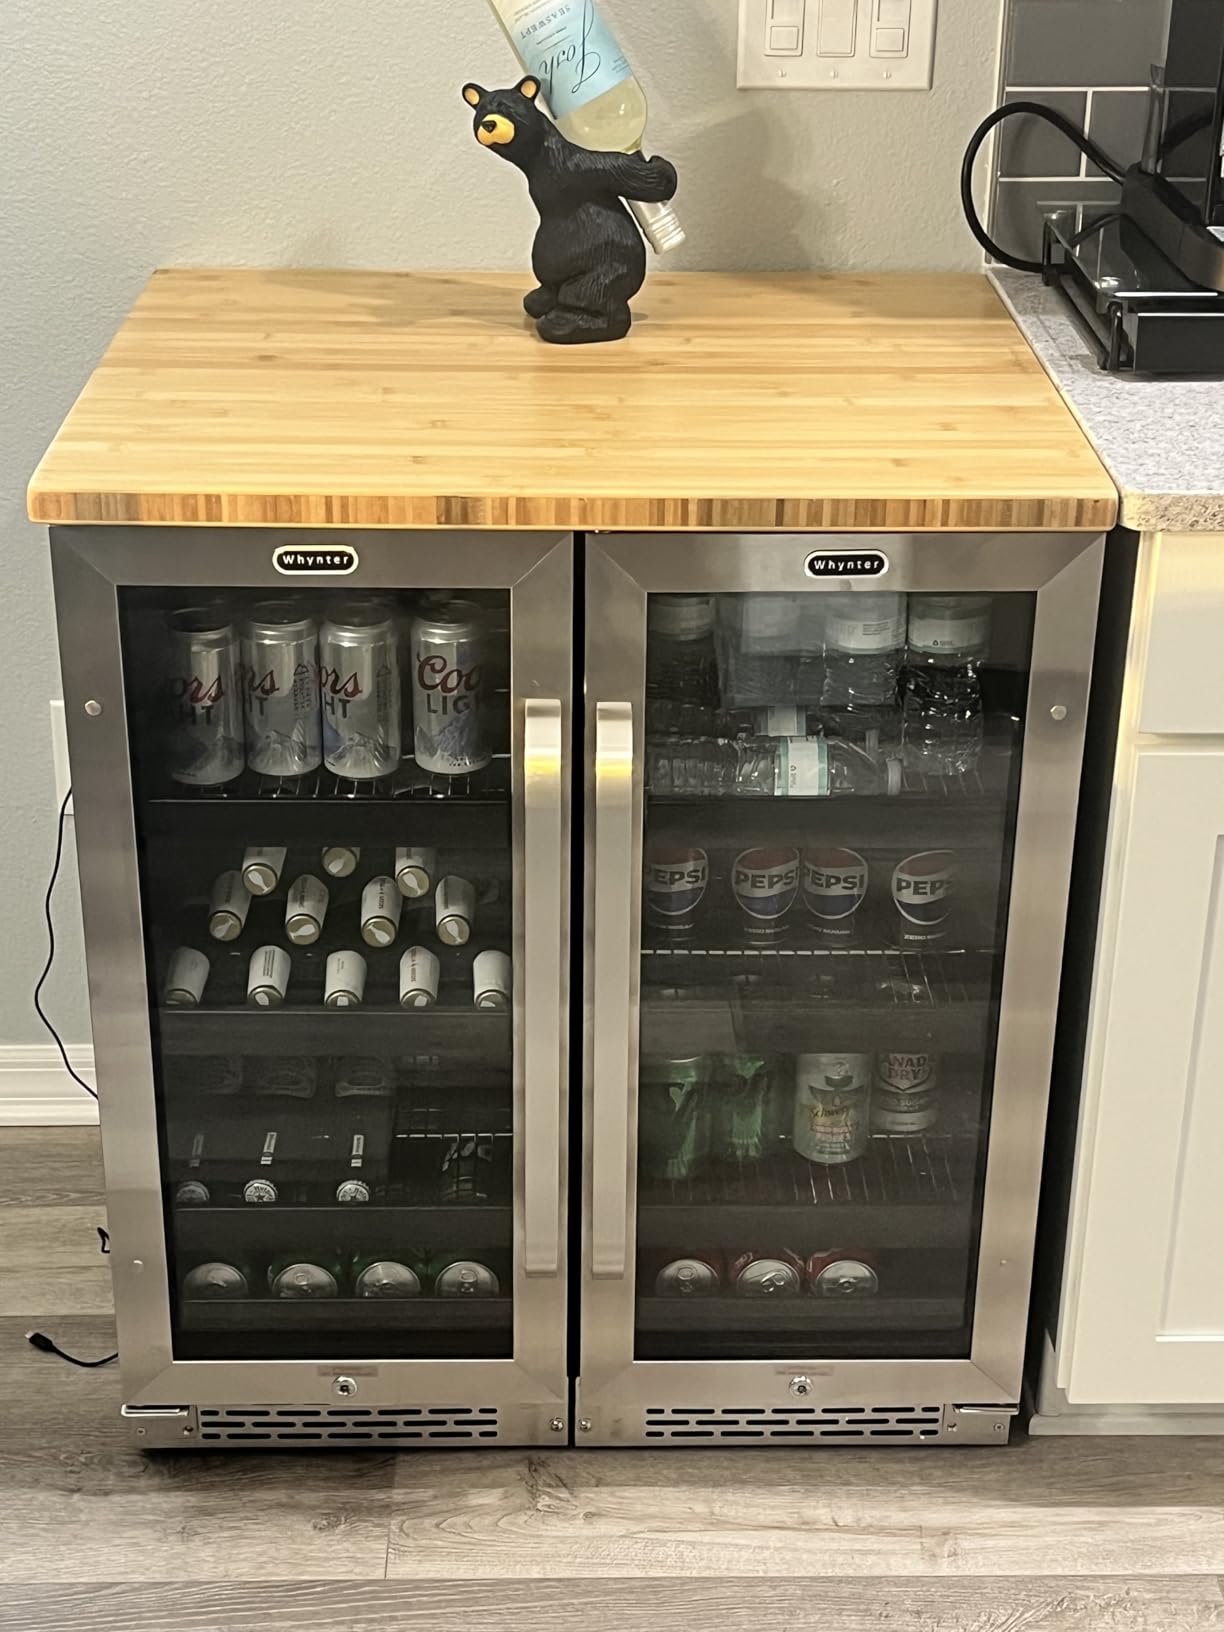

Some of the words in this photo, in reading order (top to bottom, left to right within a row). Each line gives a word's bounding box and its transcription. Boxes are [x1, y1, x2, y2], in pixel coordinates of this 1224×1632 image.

[519, 6, 571, 40] SEASWEPT
[538, 0, 601, 97] Josh
[281, 552, 349, 567] Whynter
[813, 557, 880, 571] Whynter
